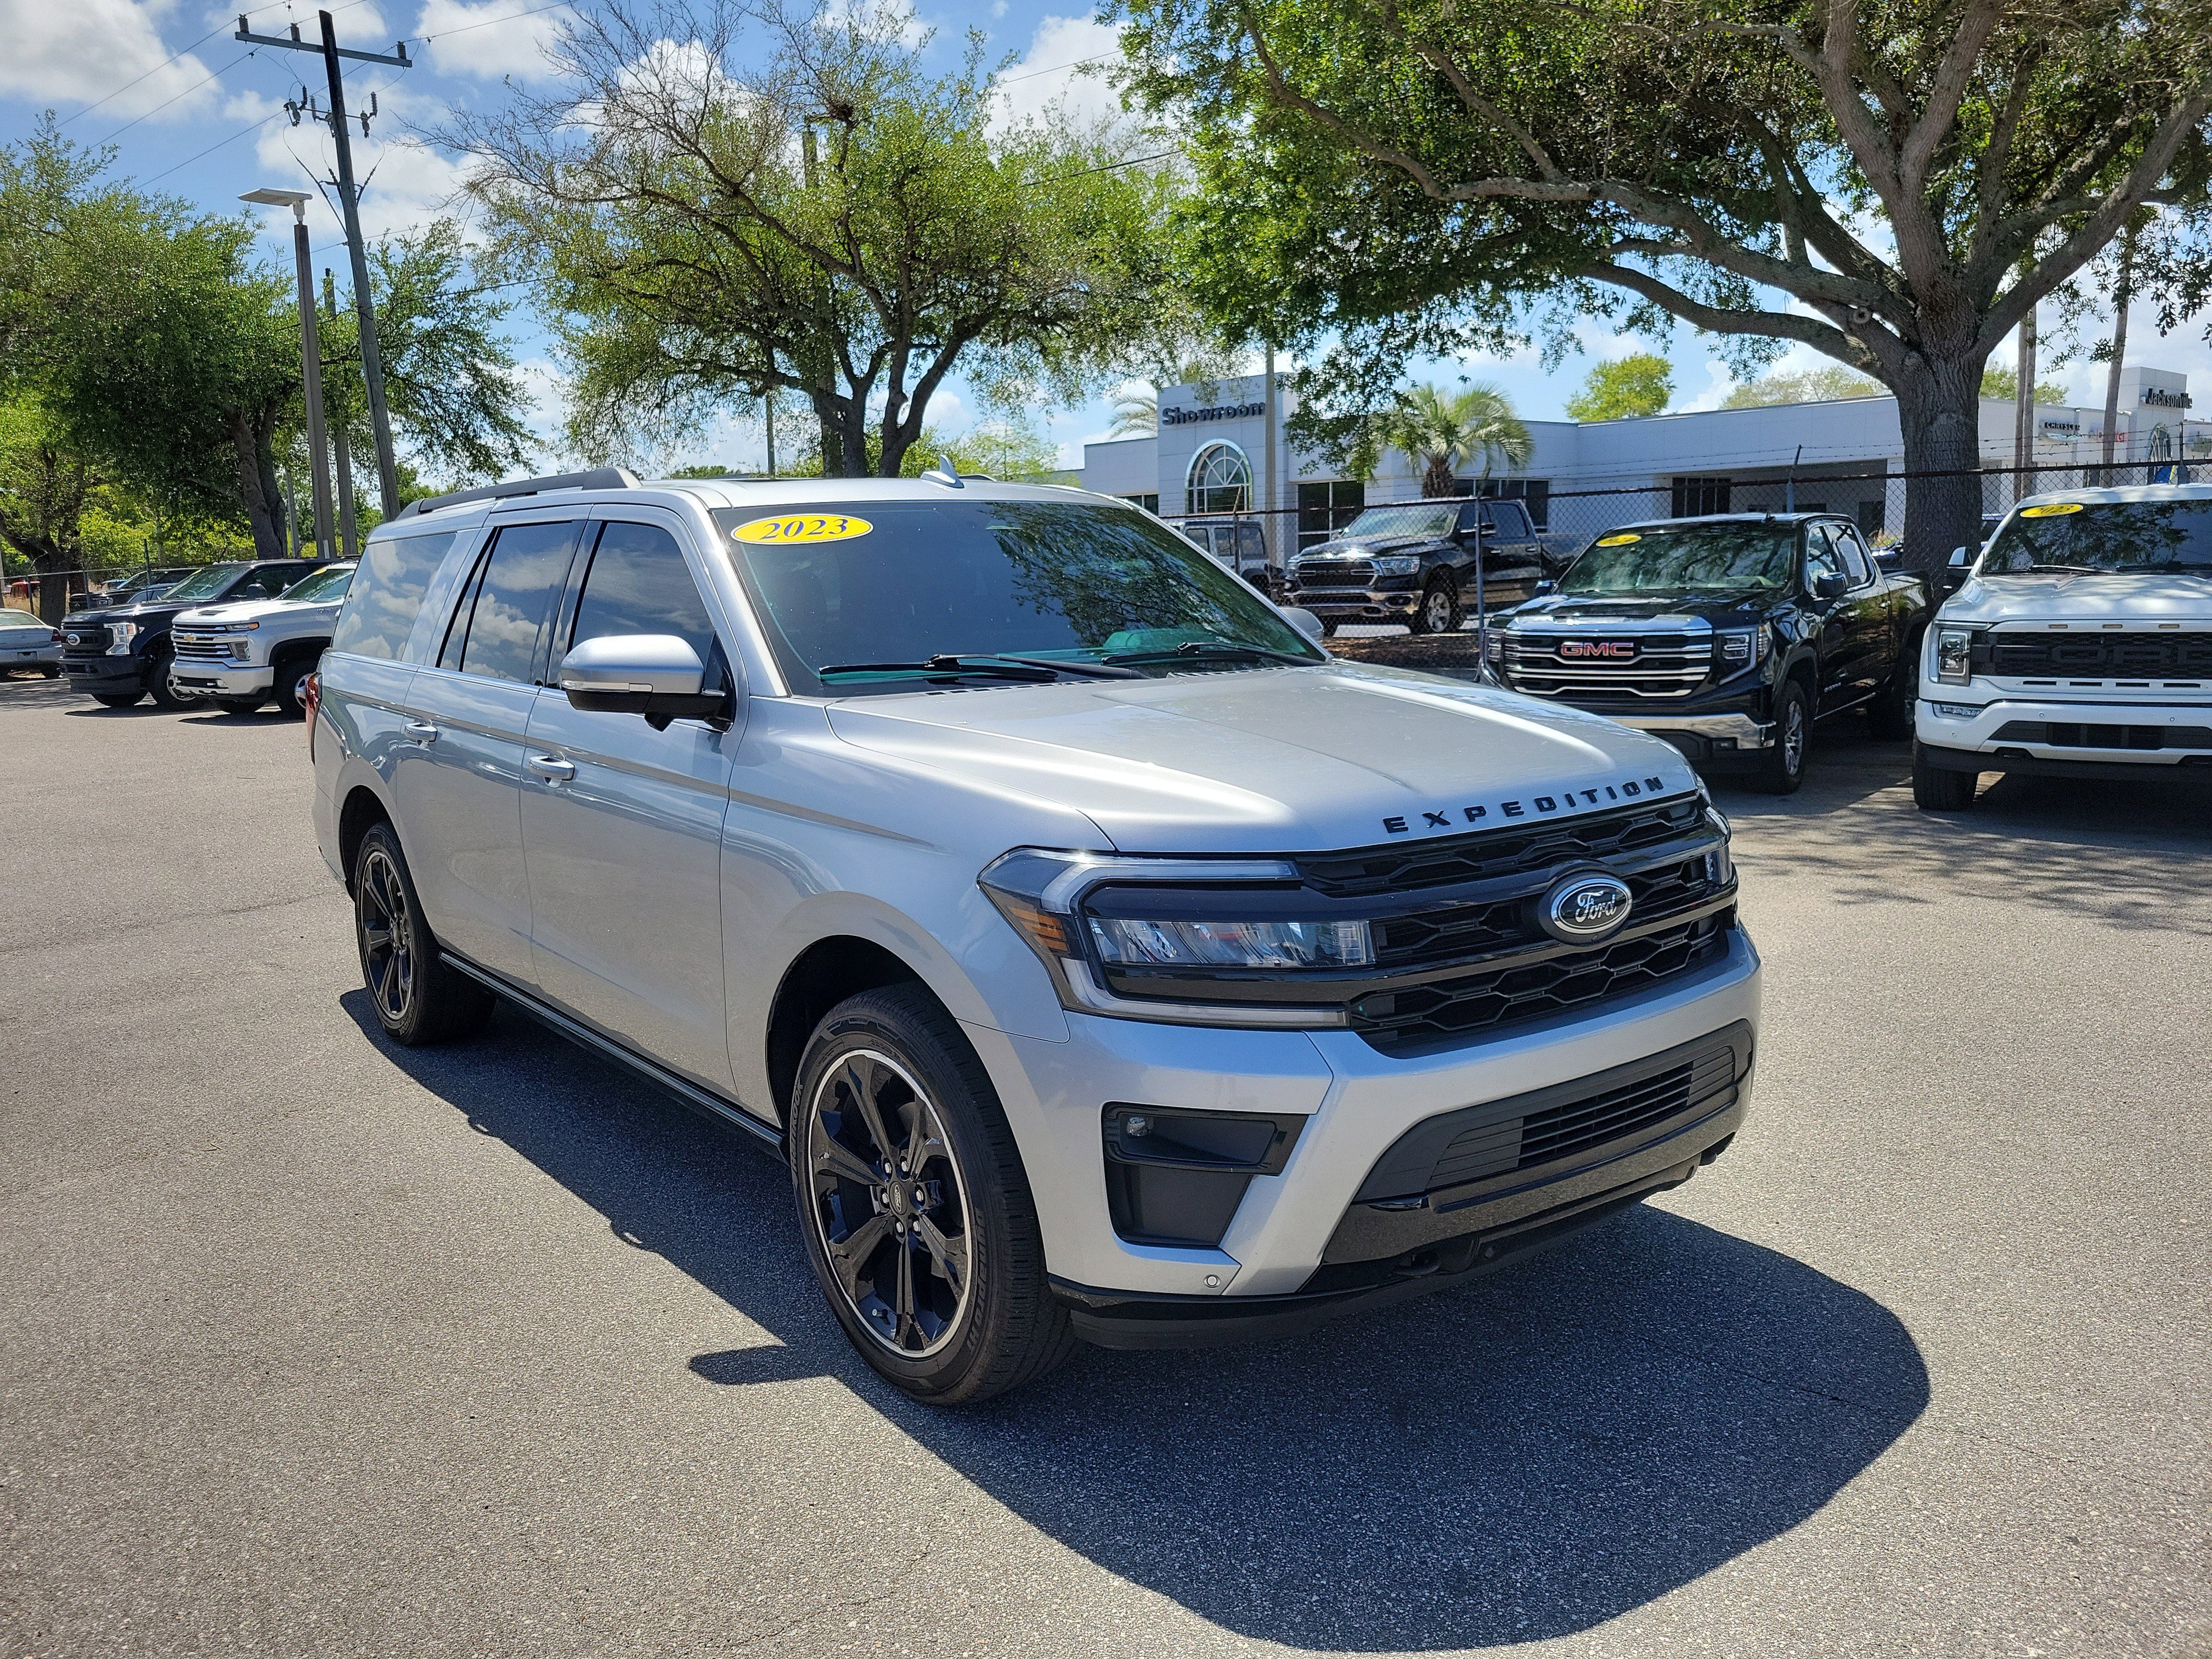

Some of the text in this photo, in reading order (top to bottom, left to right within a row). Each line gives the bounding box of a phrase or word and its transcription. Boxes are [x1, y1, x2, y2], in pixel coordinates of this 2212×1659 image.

[2146, 388, 2193, 409] Jacksonville
[1162, 402, 1266, 426] Showroom
[2044, 422, 2080, 431] CHRYSLER
[759, 518, 848, 540] 2023
[1560, 641, 1634, 657] GMC
[1382, 776, 1664, 834] EXPEDITION
[1575, 889, 1617, 923] Ford
